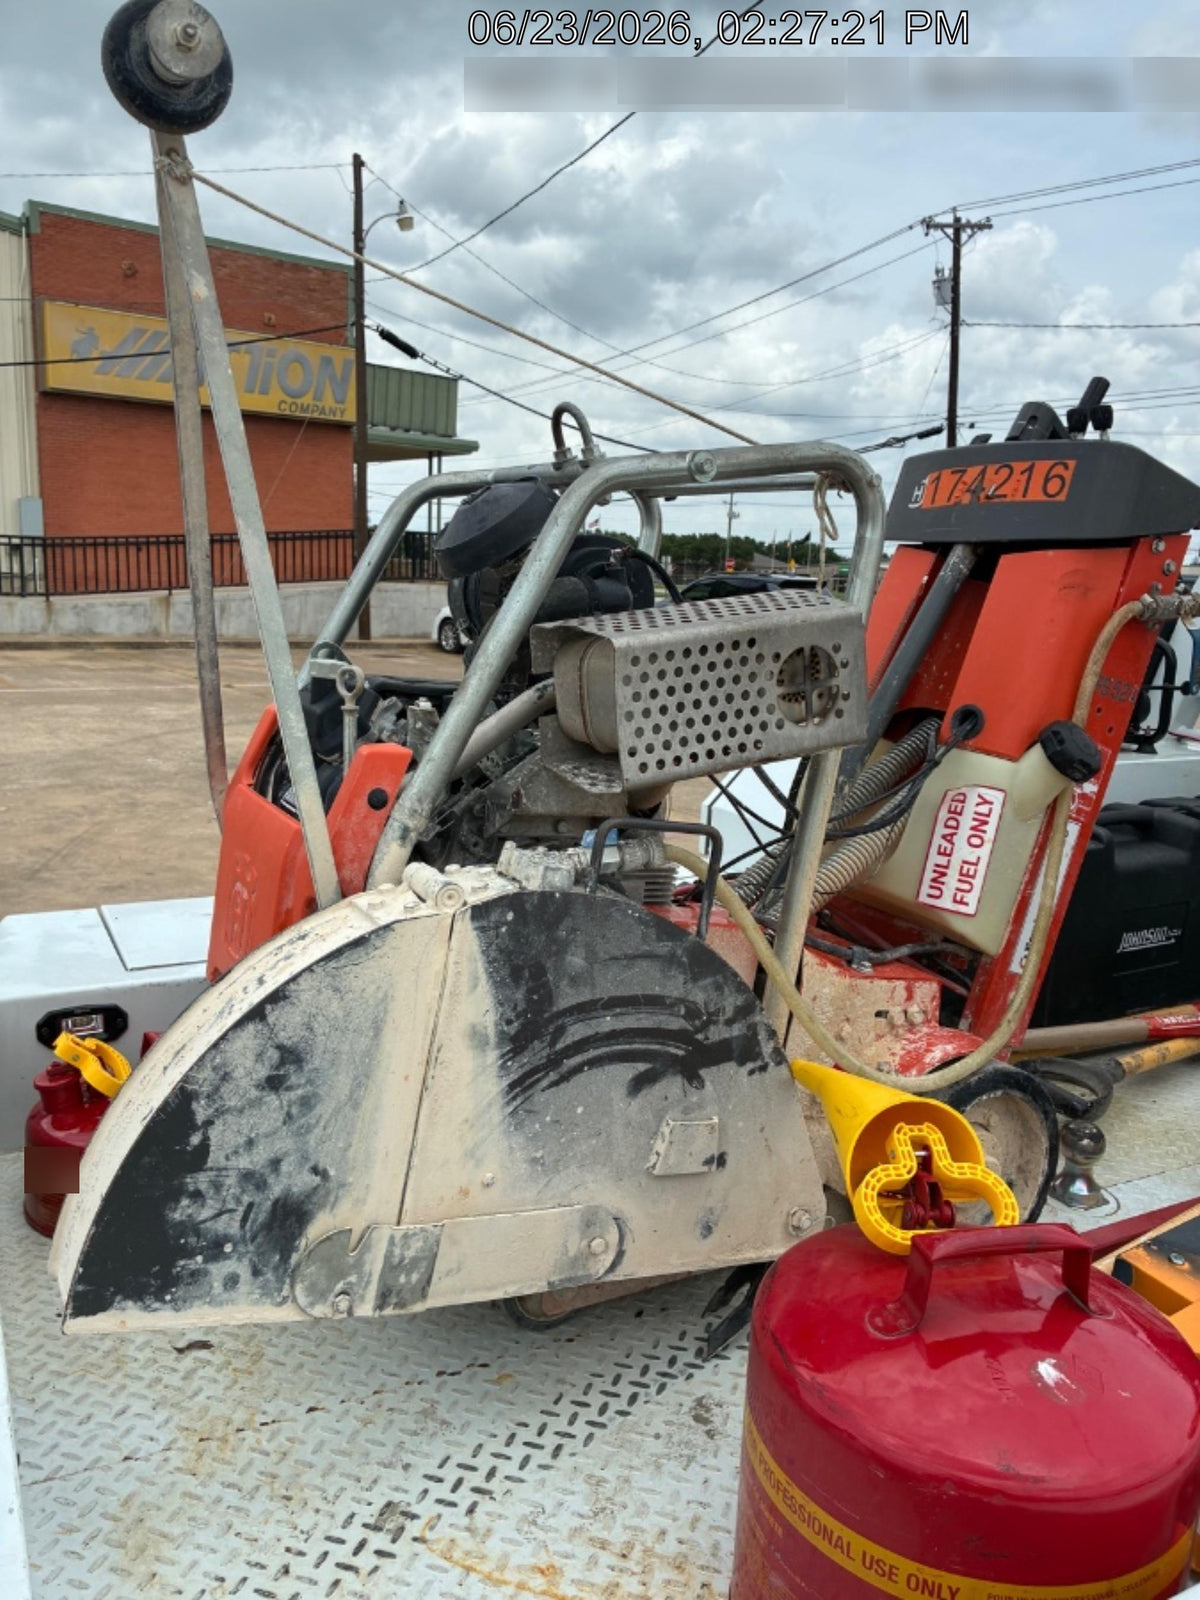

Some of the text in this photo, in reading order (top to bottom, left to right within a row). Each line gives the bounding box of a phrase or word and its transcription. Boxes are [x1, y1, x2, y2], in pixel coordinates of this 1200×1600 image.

[277, 399, 347, 419] COMPANY
[929, 461, 1069, 505] 174216
[926, 791, 967, 900] UNLEADED
[953, 792, 995, 906] FUEL ONLY
[758, 1452, 856, 1562] PROFESSIONAL
[862, 1549, 900, 1584] USE
[905, 1572, 961, 1600] ONLY
